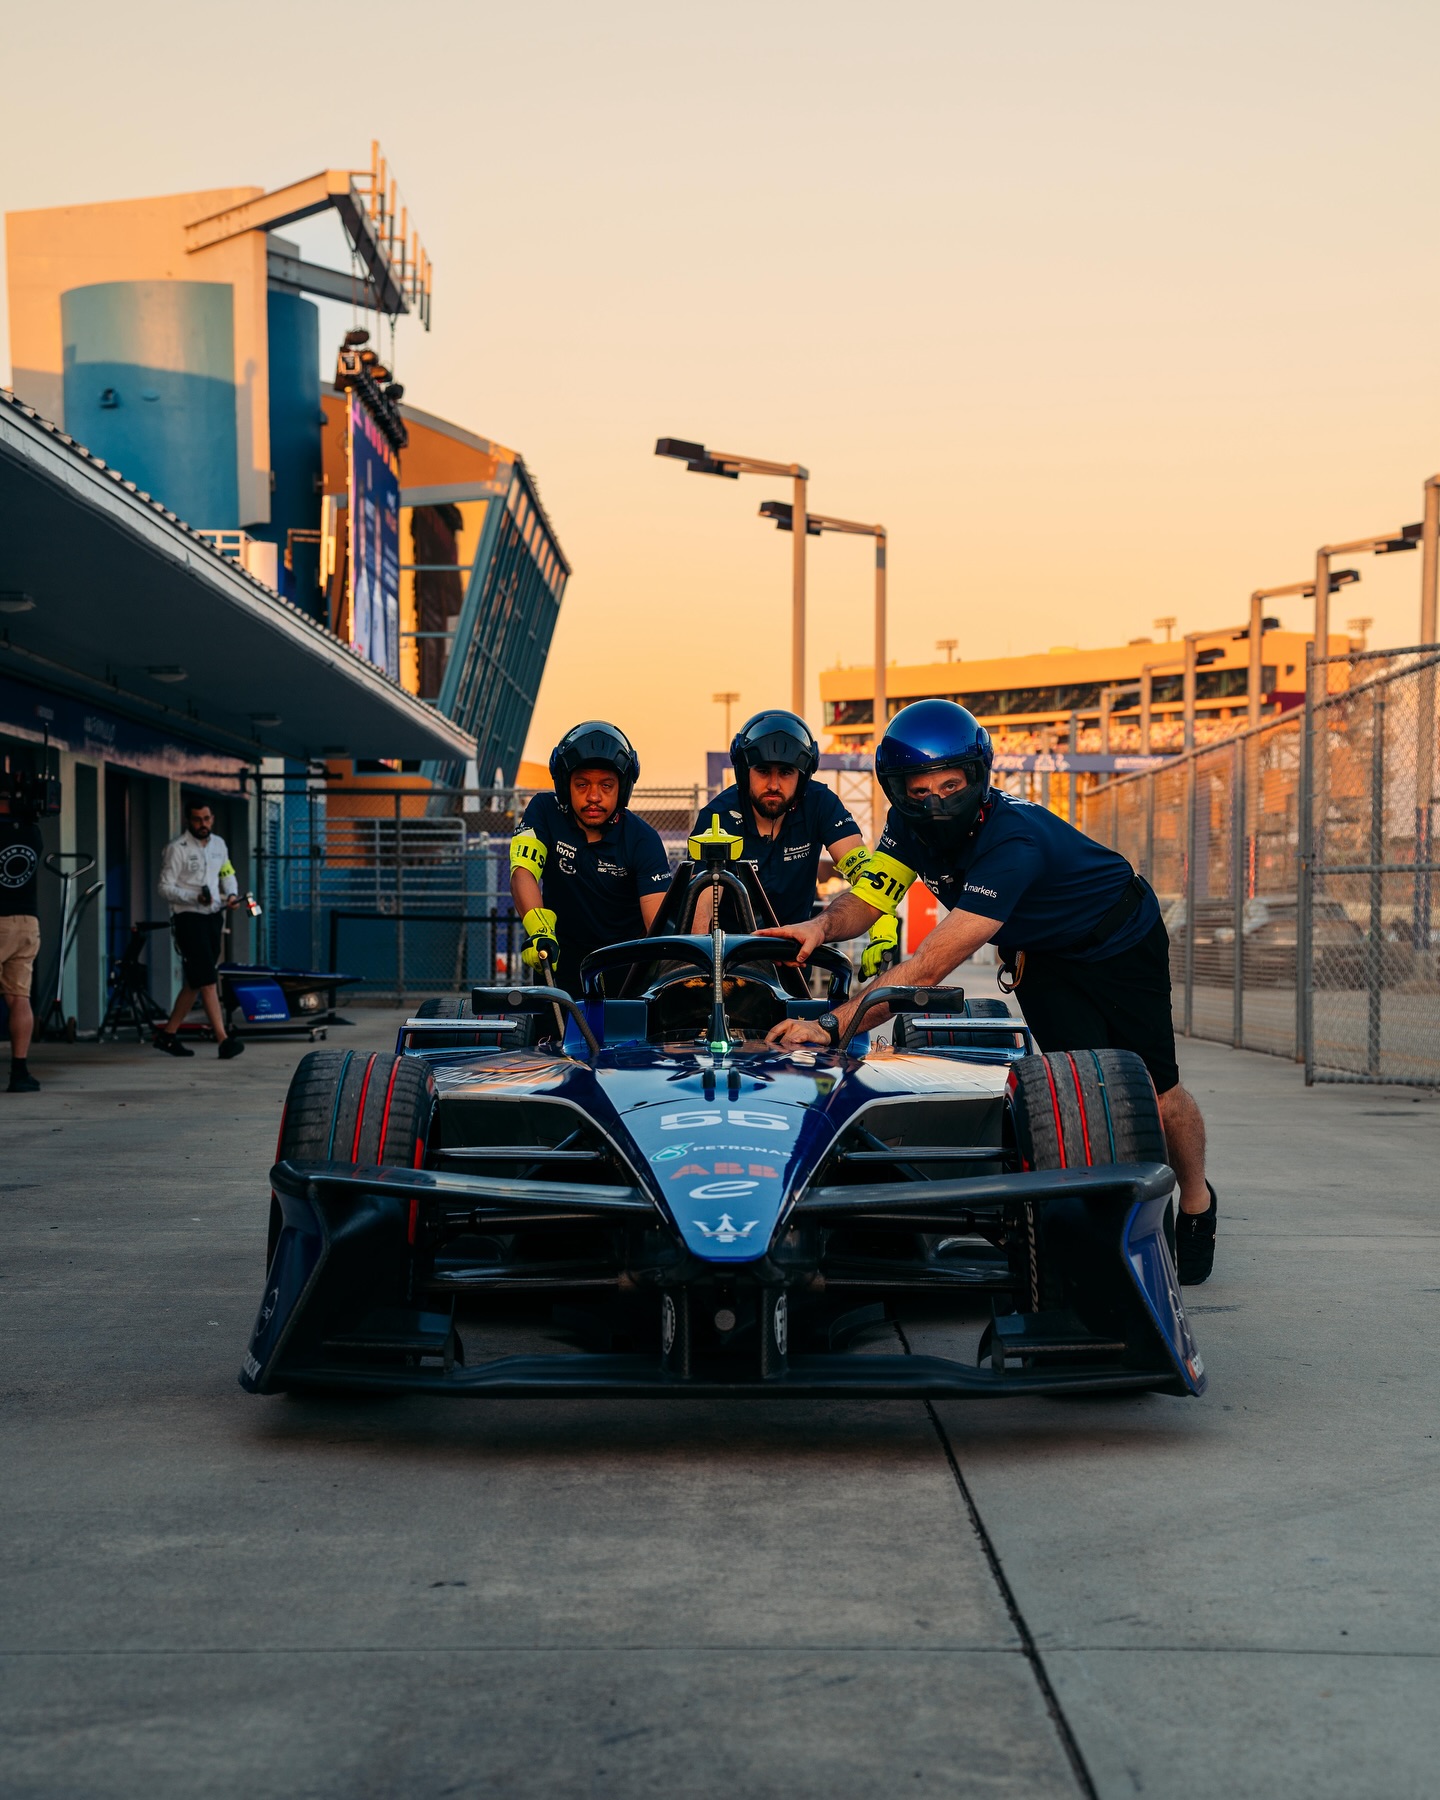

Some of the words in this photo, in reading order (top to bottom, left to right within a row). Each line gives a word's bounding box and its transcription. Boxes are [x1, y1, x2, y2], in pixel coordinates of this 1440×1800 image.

[968, 885, 998, 899] markets
[660, 1110, 790, 1131] 55
[693, 1144, 792, 1158] PETRONAS
[669, 1162, 779, 1180] ABB
